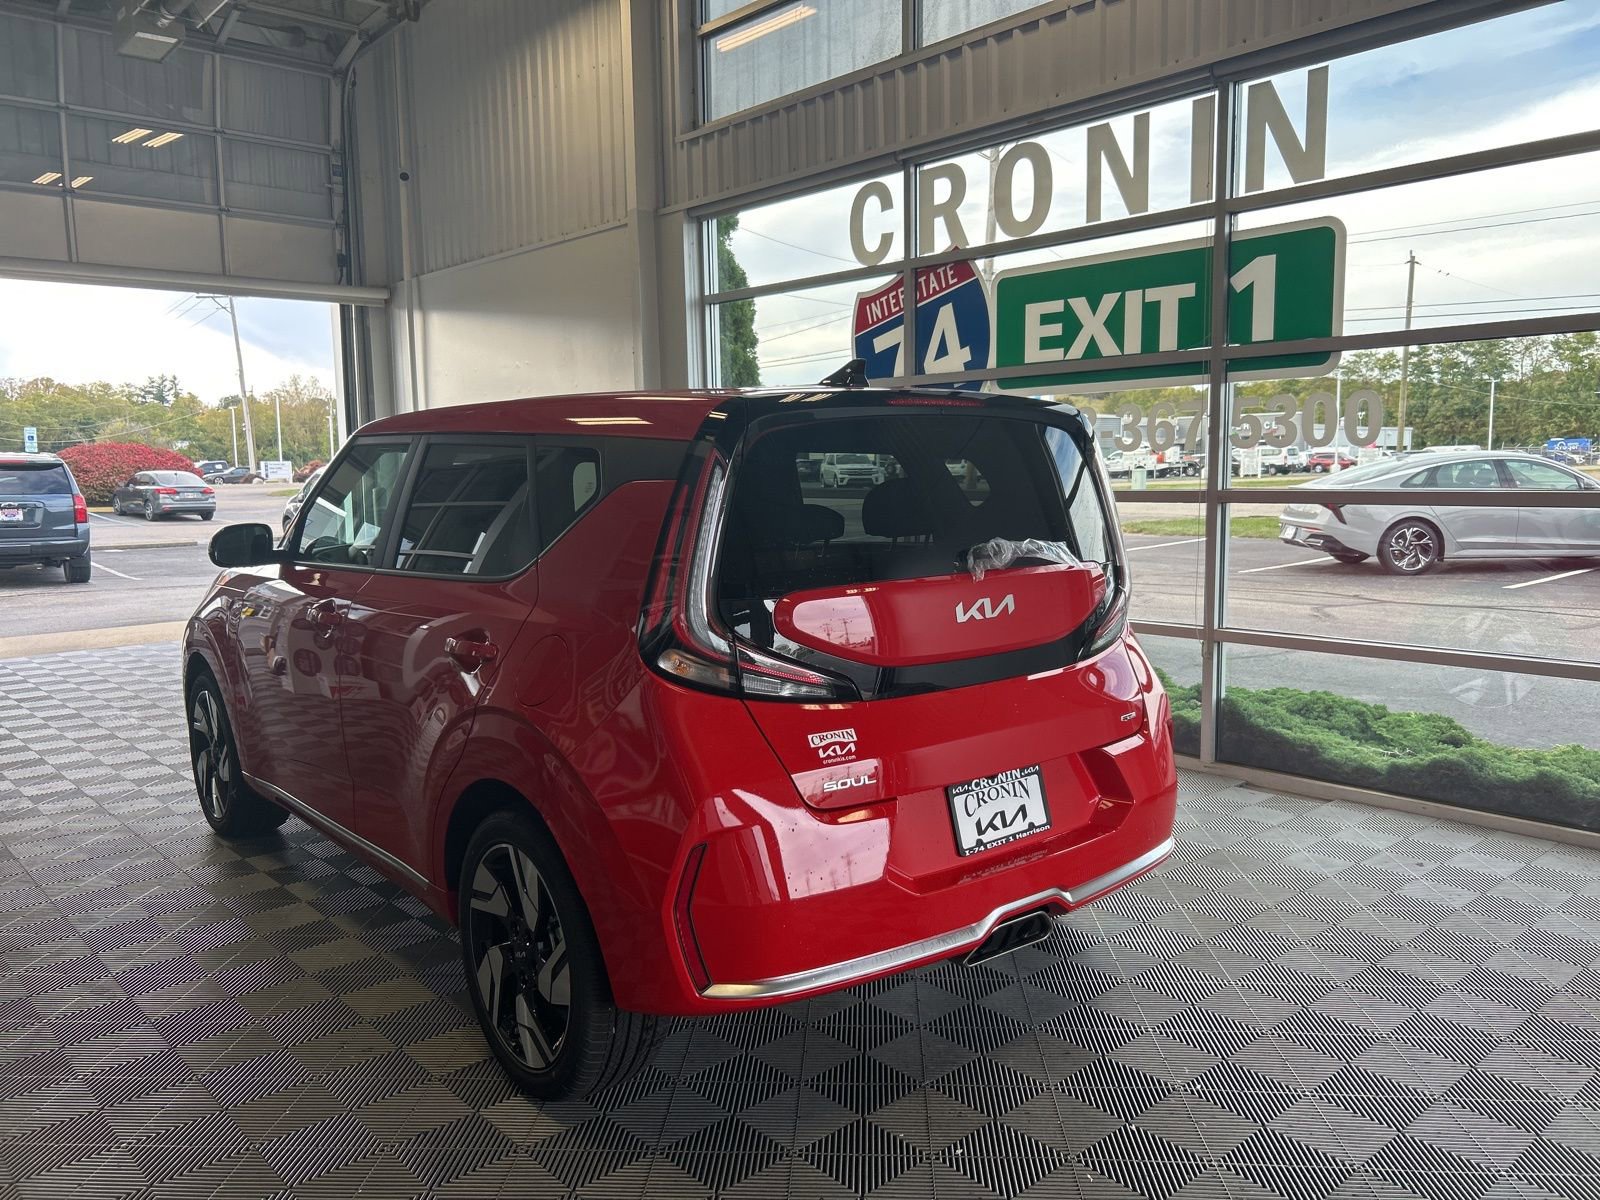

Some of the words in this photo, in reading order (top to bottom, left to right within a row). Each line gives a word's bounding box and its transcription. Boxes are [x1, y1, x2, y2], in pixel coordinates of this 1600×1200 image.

[849, 64, 1330, 266] CRONIN
[866, 262, 959, 325] INTERTATE
[1025, 283, 1196, 364] EXIT
[1230, 254, 1277, 342] 1
[873, 303, 972, 388] 74
[955, 594, 1015, 623] KIA
[810, 729, 856, 747] CRONIN
[818, 742, 856, 758] KIA
[823, 775, 877, 792] SOUL
[971, 768, 1021, 791] CRONIN
[964, 778, 1031, 818] CRONIN
[975, 803, 1028, 837] KIA
[965, 845, 985, 856] I-74
[986, 839, 1008, 849] EXIT
[1016, 825, 1051, 839] Harrison
